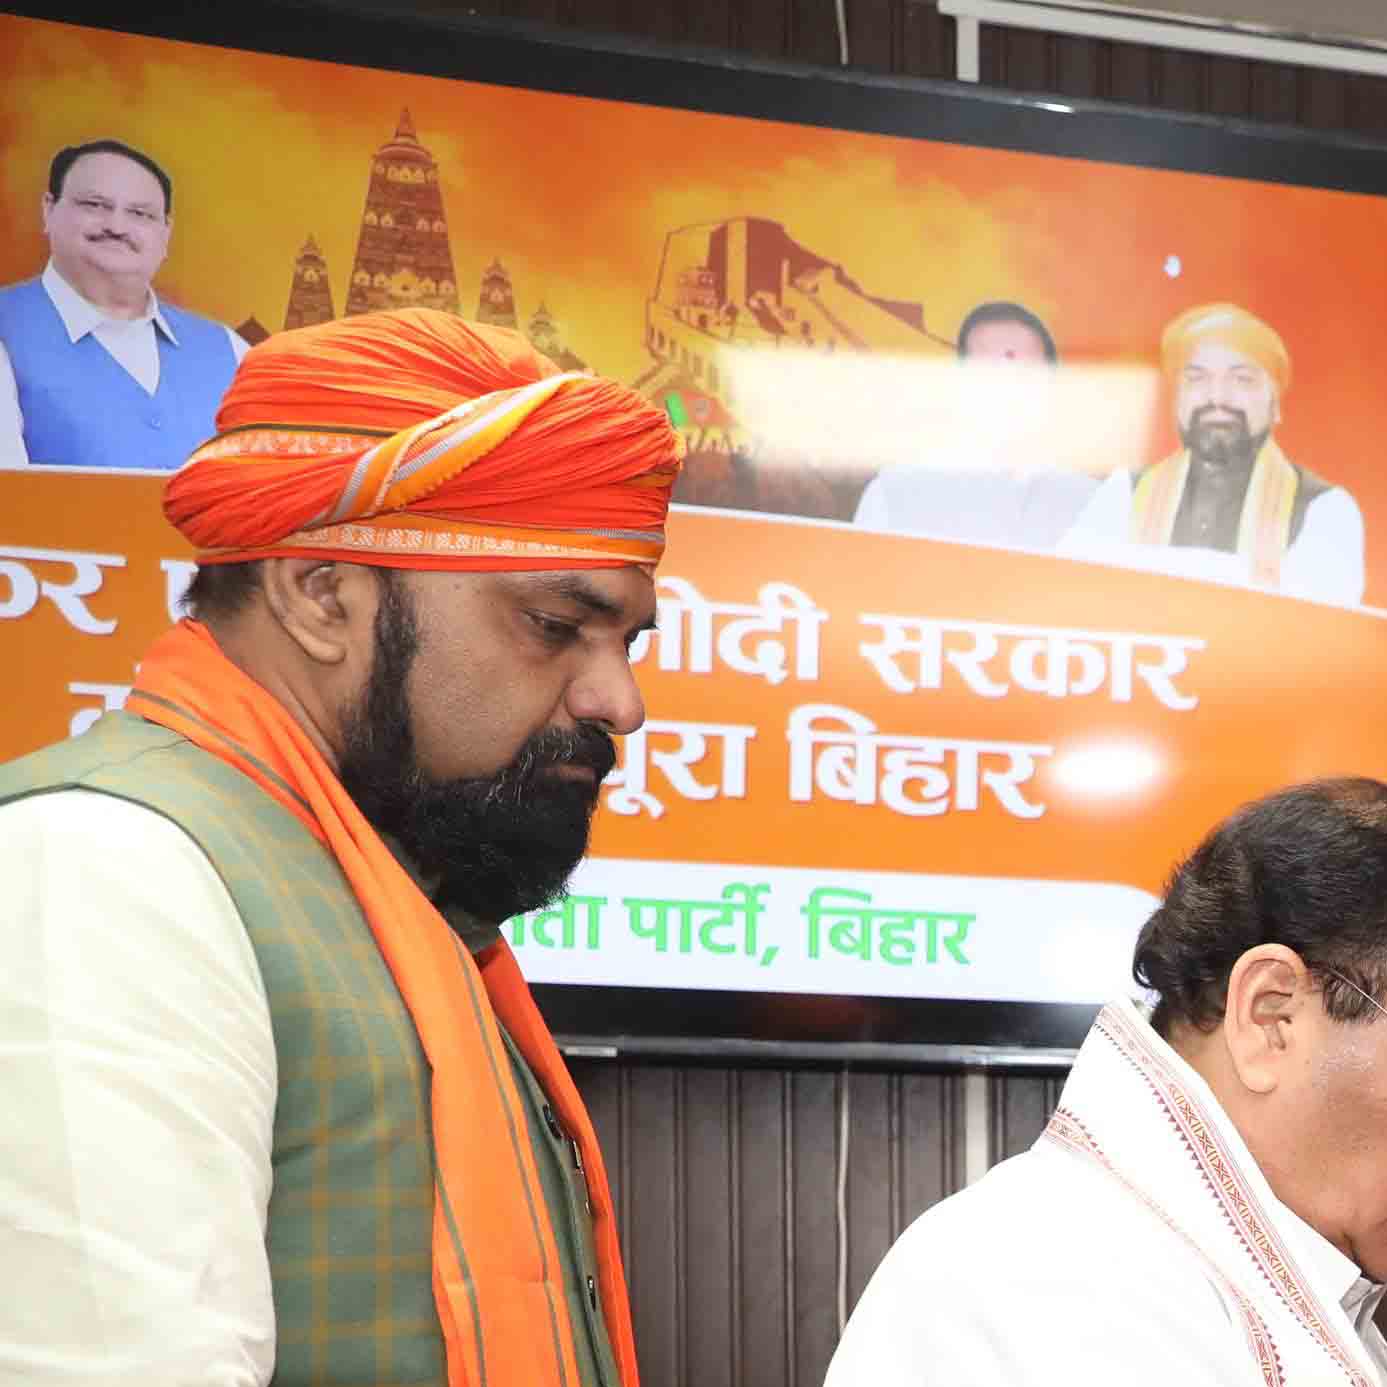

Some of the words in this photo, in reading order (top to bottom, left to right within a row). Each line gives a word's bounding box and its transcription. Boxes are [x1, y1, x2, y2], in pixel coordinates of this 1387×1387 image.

[858, 612, 1209, 711] सरकार
[786, 703, 1055, 820] बिहार
[622, 881, 780, 967] पार्टी,
[800, 886, 976, 966] बिहार
